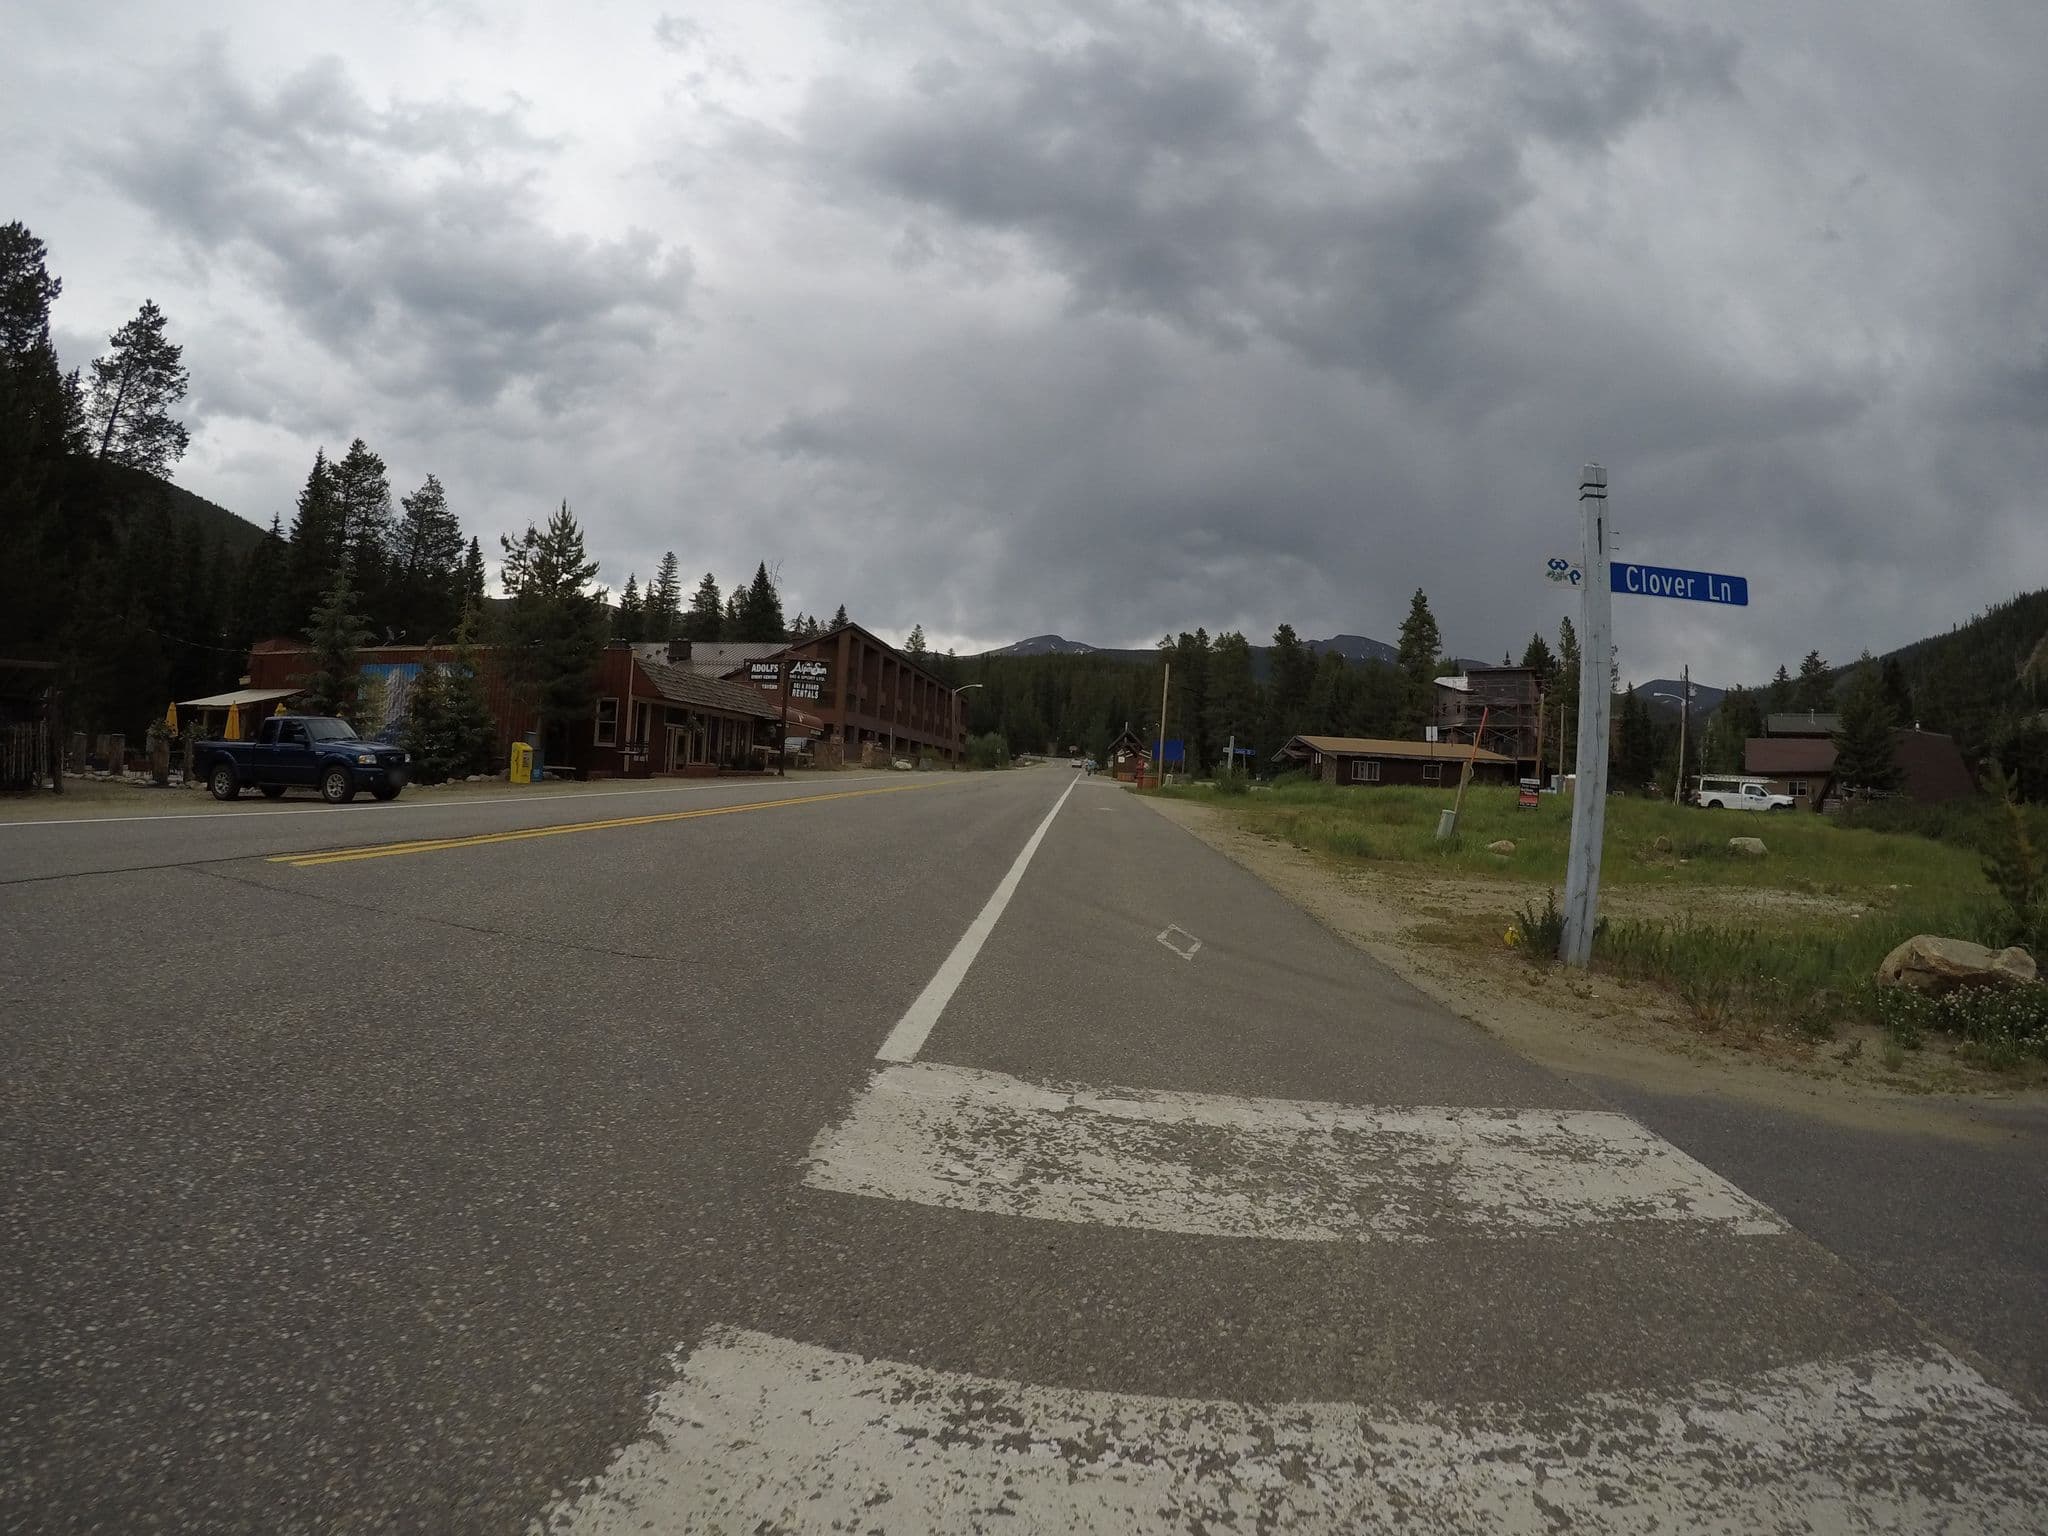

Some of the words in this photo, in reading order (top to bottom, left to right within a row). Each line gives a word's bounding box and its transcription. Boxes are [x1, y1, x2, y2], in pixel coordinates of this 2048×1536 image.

[1625, 566, 1695, 598] Clover
[1708, 575, 1732, 602] Ln
[792, 689, 818, 699] RENTALS
